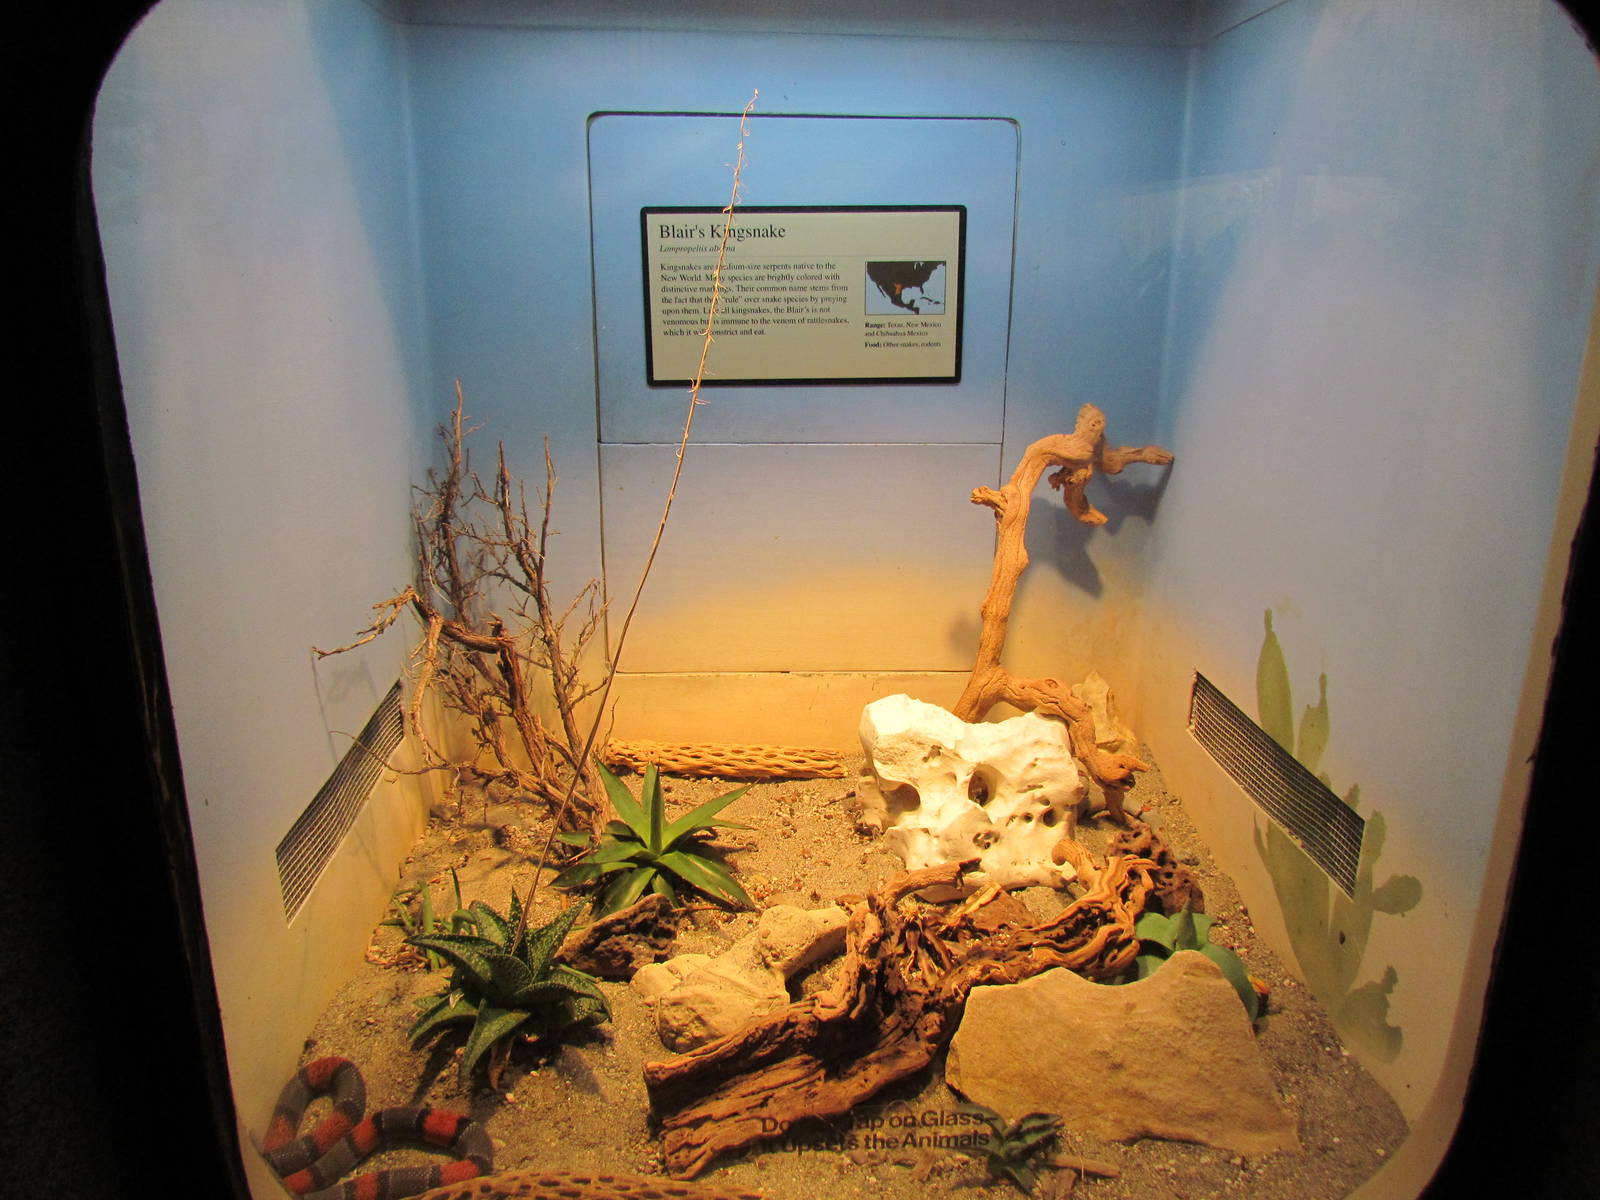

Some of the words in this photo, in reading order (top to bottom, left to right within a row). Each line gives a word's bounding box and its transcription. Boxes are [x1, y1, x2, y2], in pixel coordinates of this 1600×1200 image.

[660, 224, 706, 239] Blair's
[711, 224, 786, 242] Kingsnake
[660, 245, 707, 253] Lampropeltis
[660, 263, 702, 272] Kingsnakes
[763, 263, 791, 271] serpents
[826, 262, 837, 270] the
[728, 275, 752, 283] species
[767, 273, 794, 283] brightly
[796, 273, 823, 281] colored
[825, 273, 841, 281] with
[661, 285, 698, 293] distinctive
[832, 283, 848, 291] from
[690, 296, 703, 304] that
[705, 296, 719, 306] thy
[762, 295, 782, 303] snake
[784, 296, 809, 304] species
[810, 295, 818, 304] by
[820, 295, 848, 304] preying
[662, 307, 680, 316] upon
[731, 306, 772, 315] kingsnakes,
[787, 305, 810, 313] Blair's
[722, 317, 749, 325] immune
[751, 317, 758, 325] to
[760, 316, 771, 325] the
[798, 316, 805, 324] of
[865, 321, 885, 329] Range:
[740, 328, 753, 336] and
[754, 328, 767, 336] eat.
[890, 1112, 918, 1128] on
[920, 1109, 985, 1127] Glass
[865, 1133, 900, 1151] the
[902, 1130, 991, 1150] Animals
